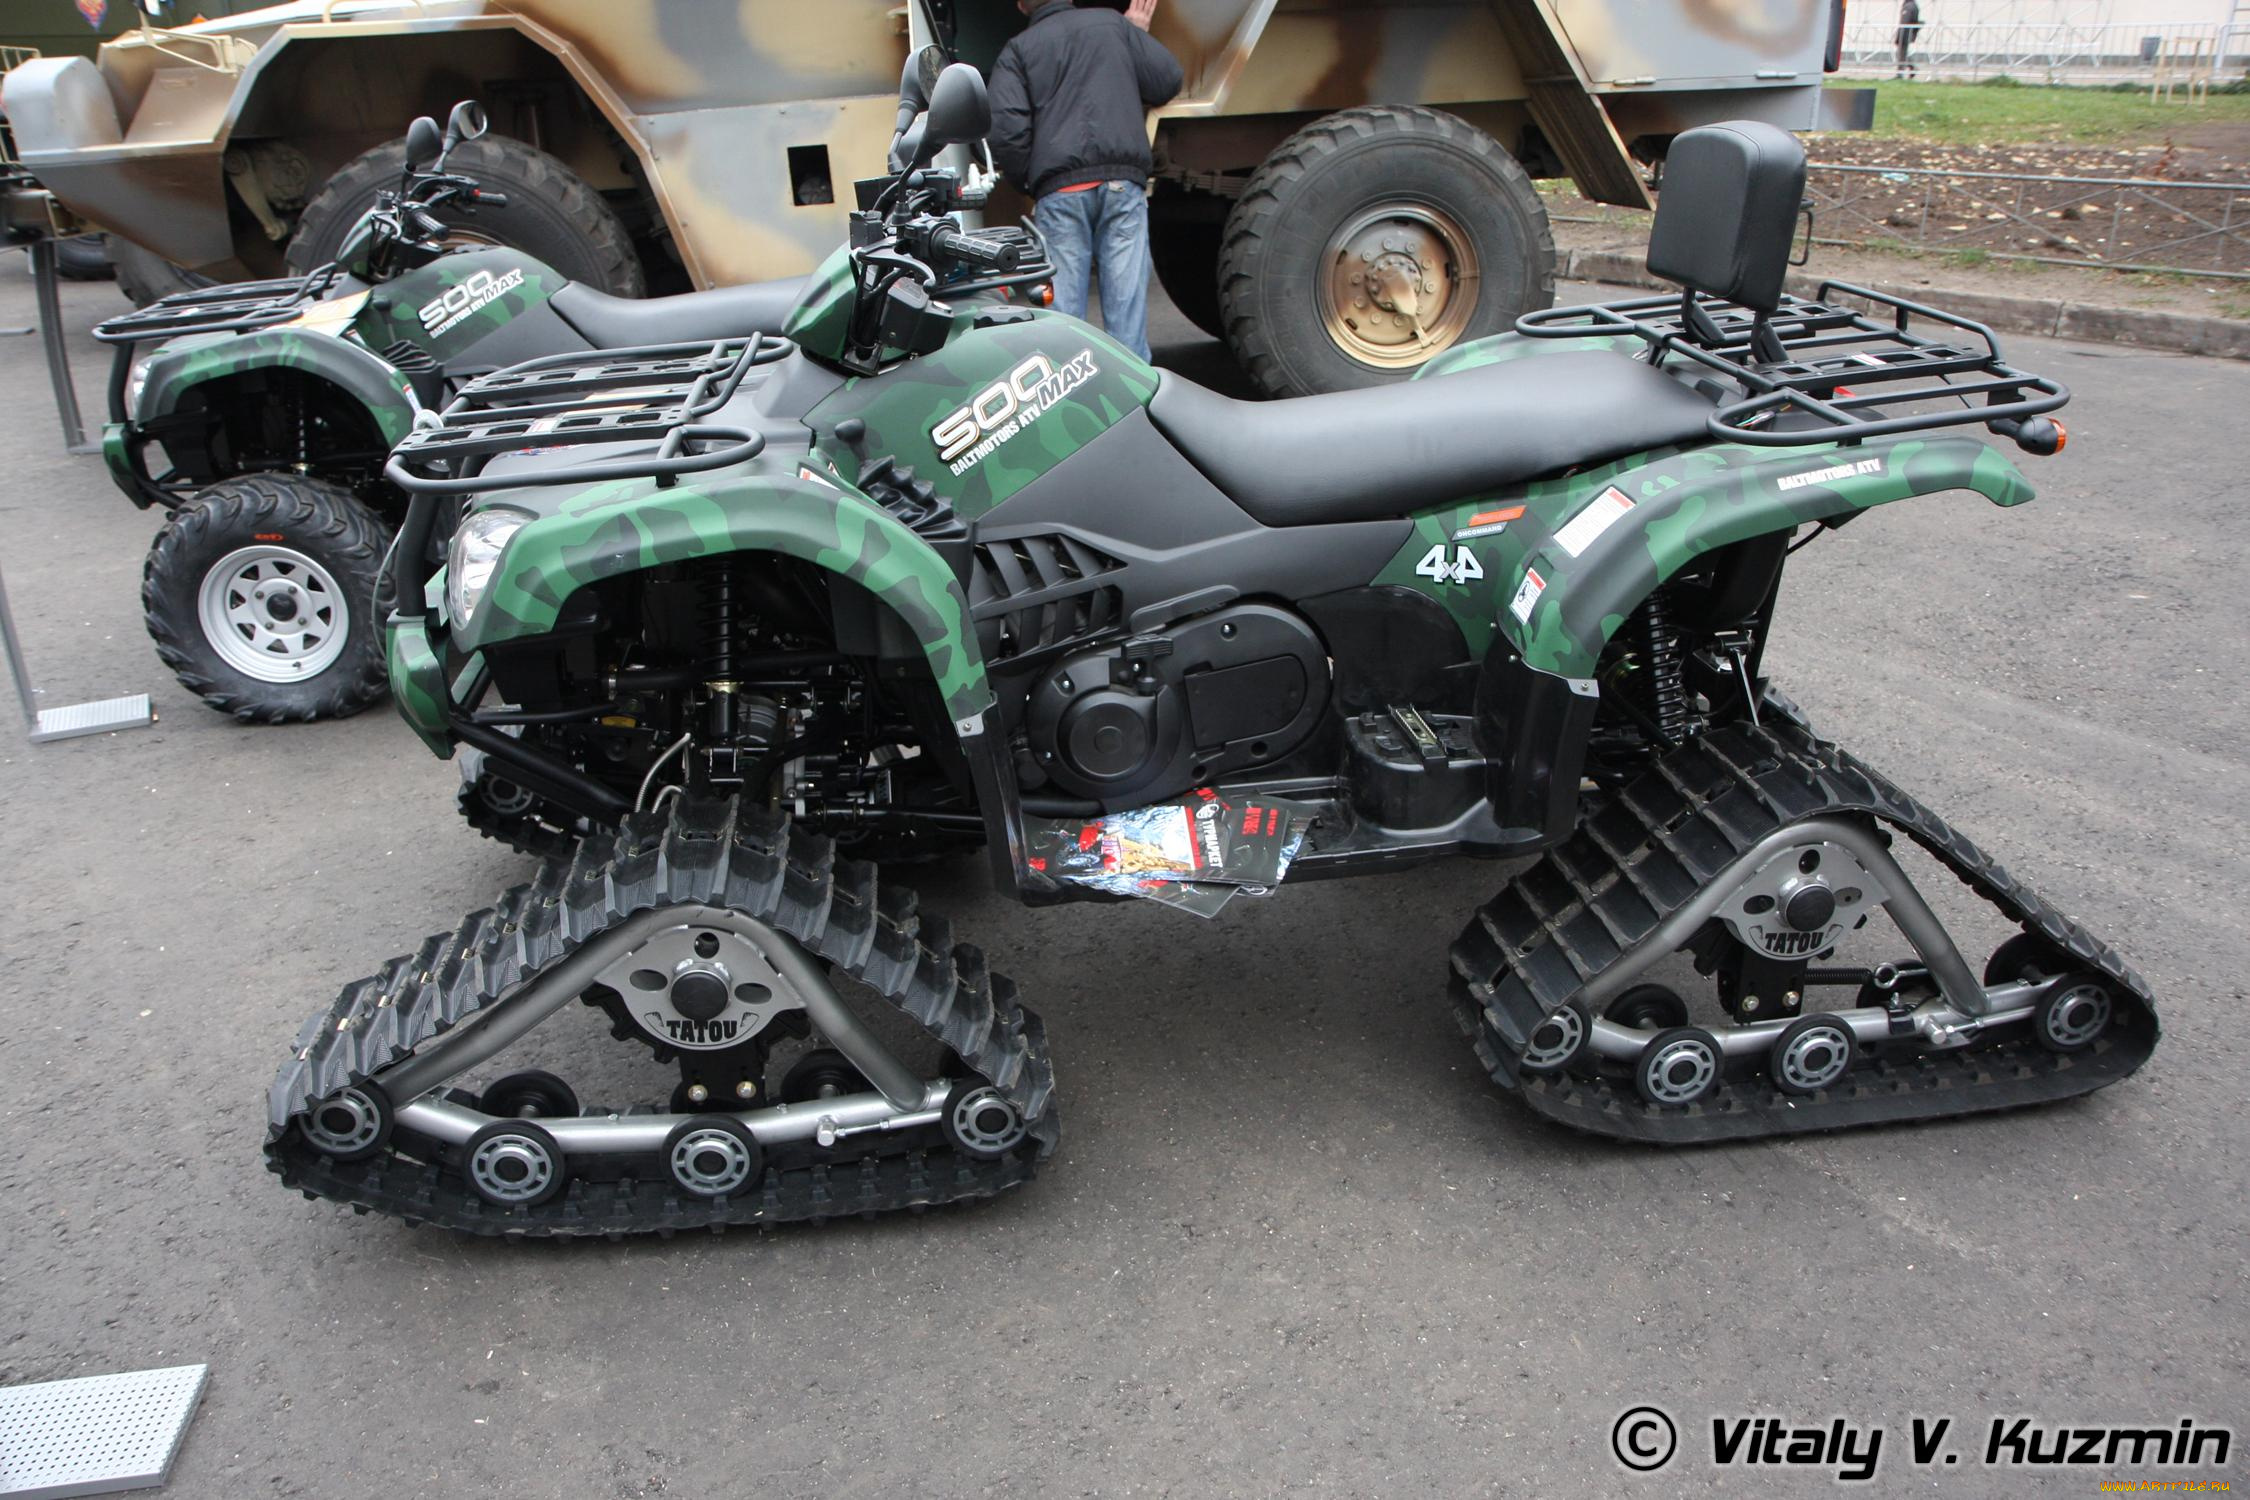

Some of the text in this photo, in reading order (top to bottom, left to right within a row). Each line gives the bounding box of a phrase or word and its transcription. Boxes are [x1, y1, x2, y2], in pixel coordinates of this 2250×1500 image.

[418, 268, 524, 330] 500 MAX
[931, 350, 1098, 462] 500 MAX
[949, 403, 1042, 477] BALTMOTORS ATV
[1777, 458, 1881, 491] BALTMOTORS ATV
[1764, 931, 1824, 954] TATOU
[666, 1020, 738, 1043] TATOU
